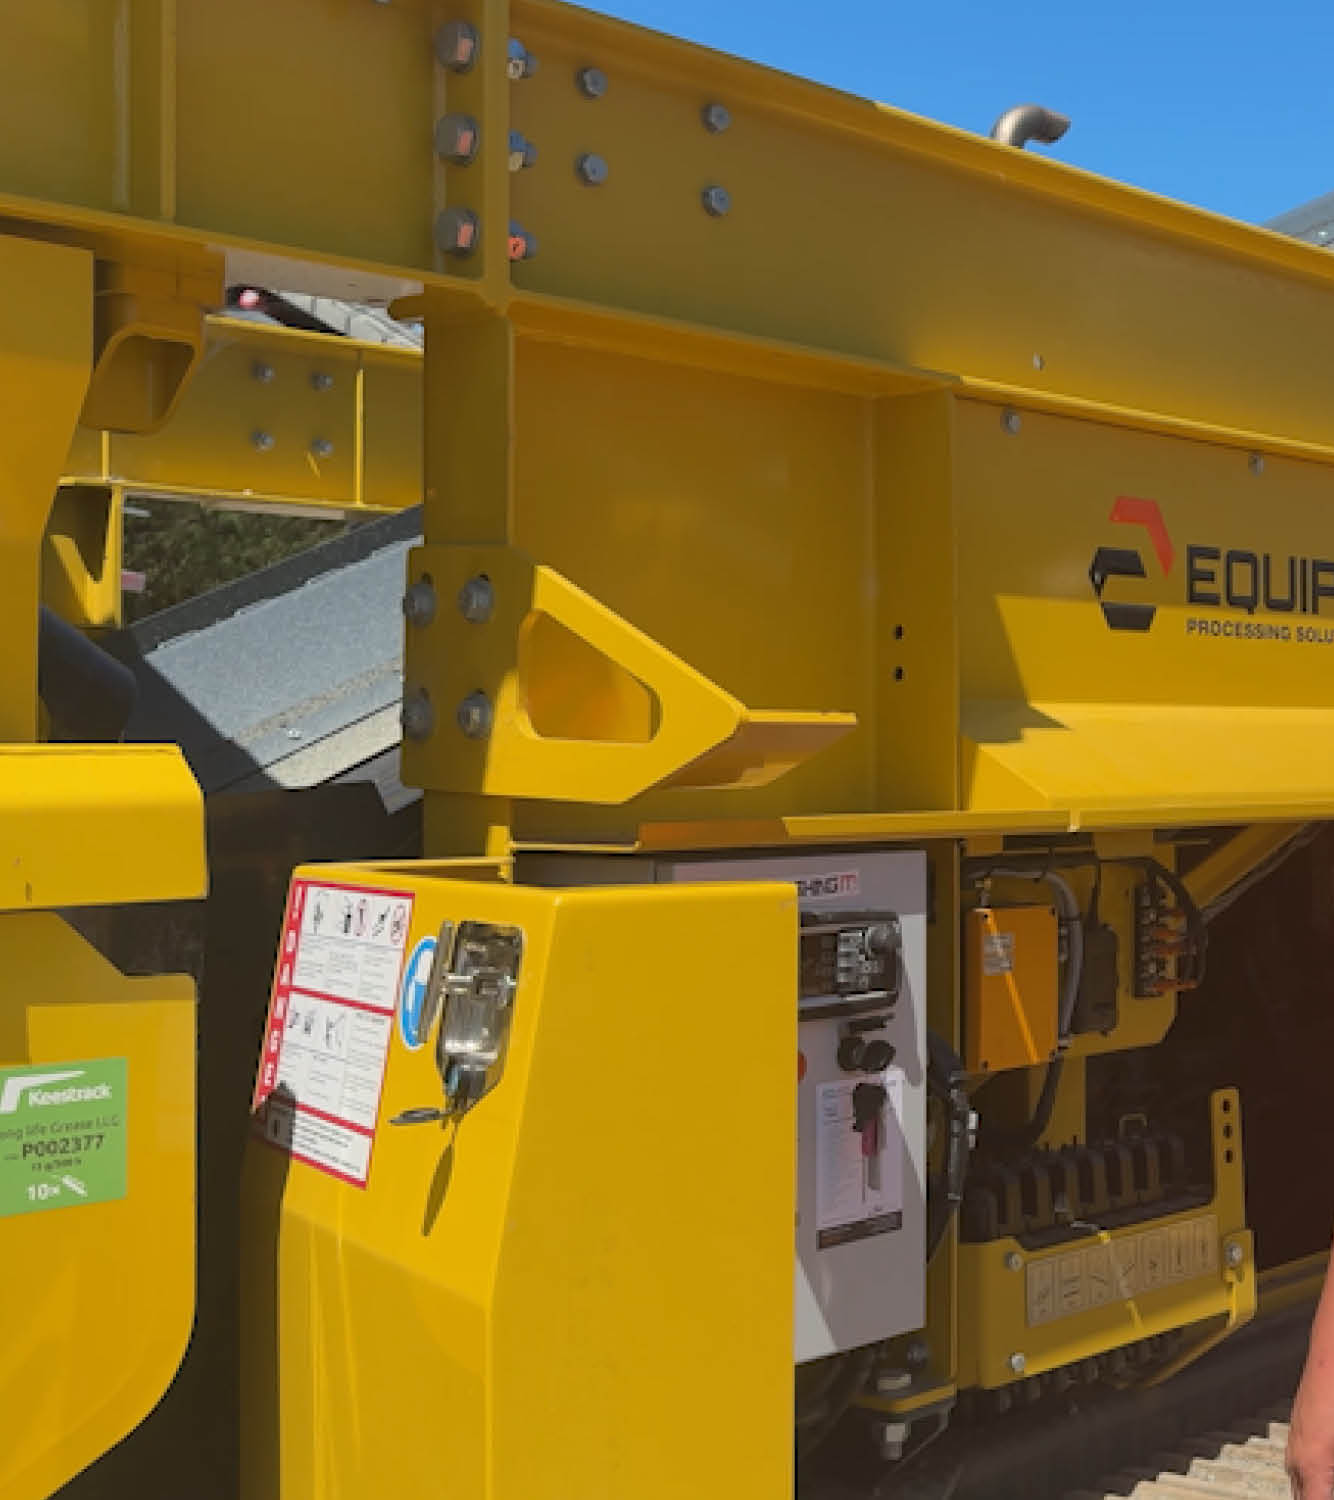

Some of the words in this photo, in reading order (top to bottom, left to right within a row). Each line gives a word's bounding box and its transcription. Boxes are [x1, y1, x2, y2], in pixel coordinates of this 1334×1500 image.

[1187, 617, 1292, 642] PROCESSING
[28, 1085, 112, 1106] Keestrack
[22, 1133, 104, 1160] P002377
